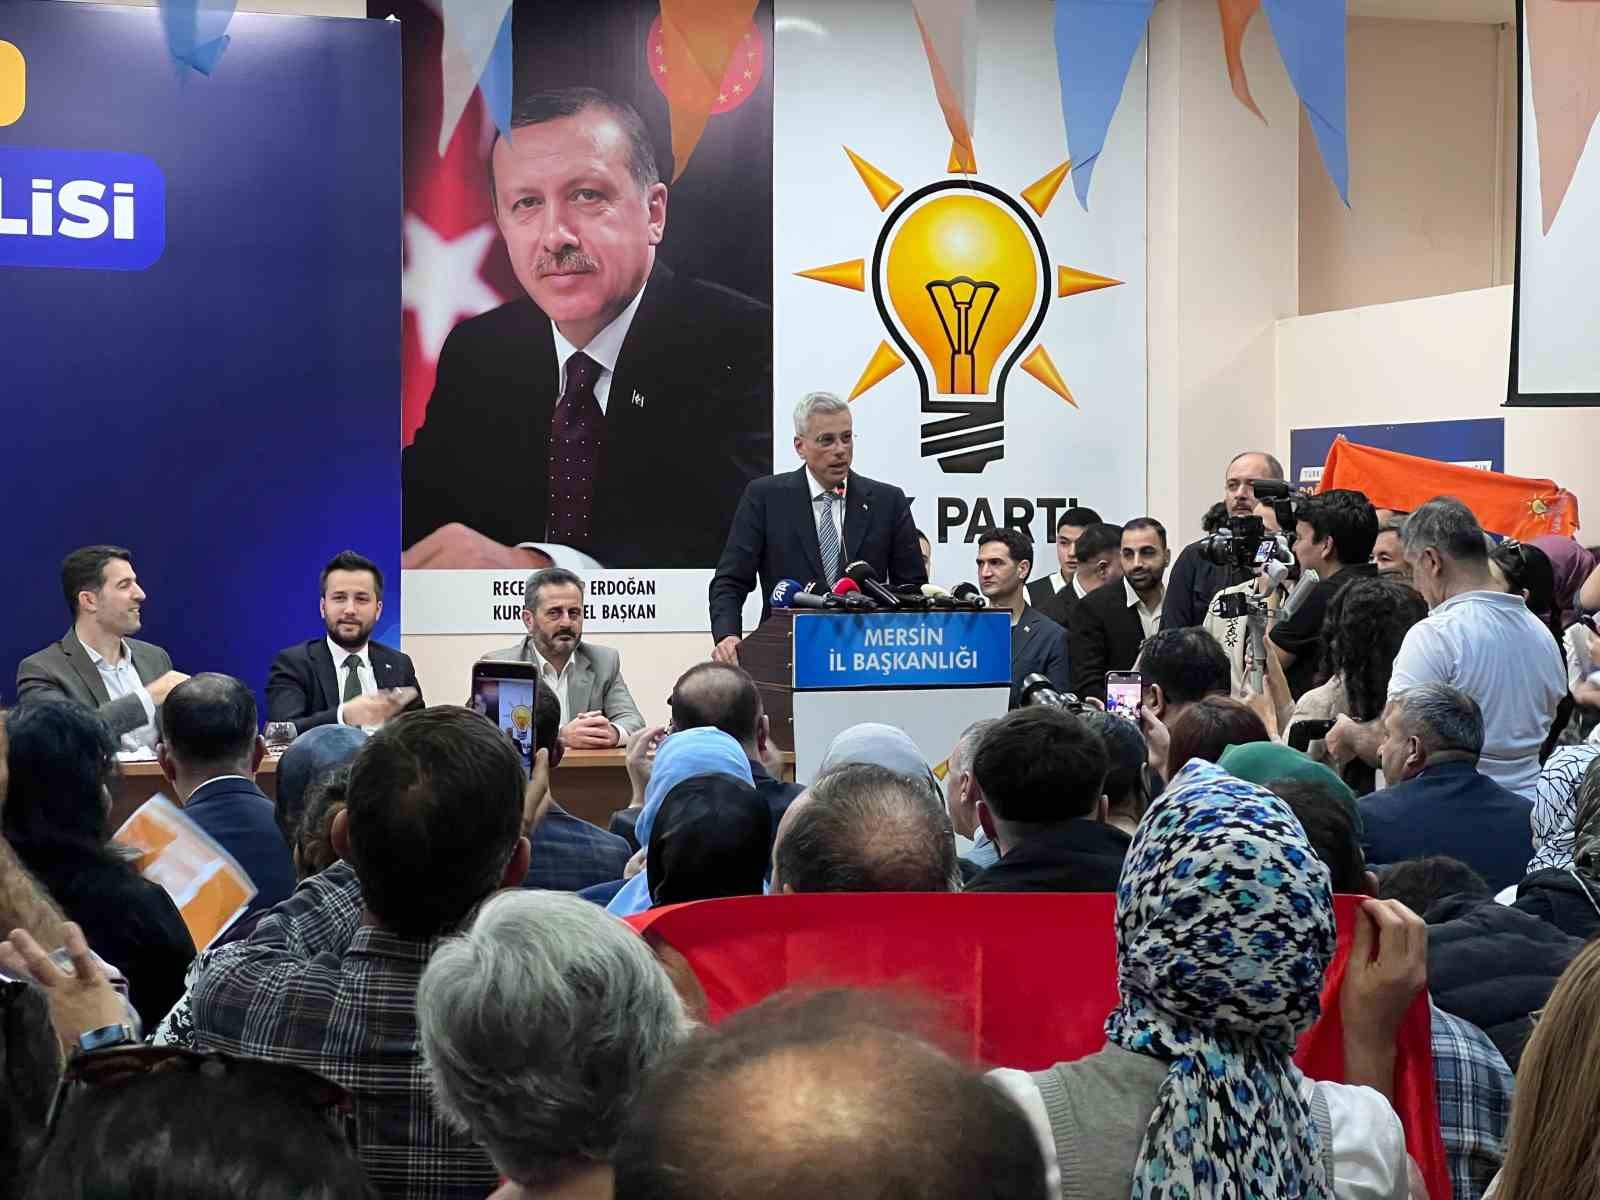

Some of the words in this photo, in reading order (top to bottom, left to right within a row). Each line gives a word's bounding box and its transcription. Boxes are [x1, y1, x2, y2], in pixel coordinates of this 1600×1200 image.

[938, 497, 1078, 544] PART
[493, 580, 526, 596] RECE
[590, 576, 656, 596] ERDOĞAN
[493, 604, 525, 620] KUR
[602, 603, 656, 623] BAŞKAN
[864, 623, 944, 647] MERSİN
[829, 648, 847, 671] İL
[853, 645, 977, 676] BAŞKANLIĞI
